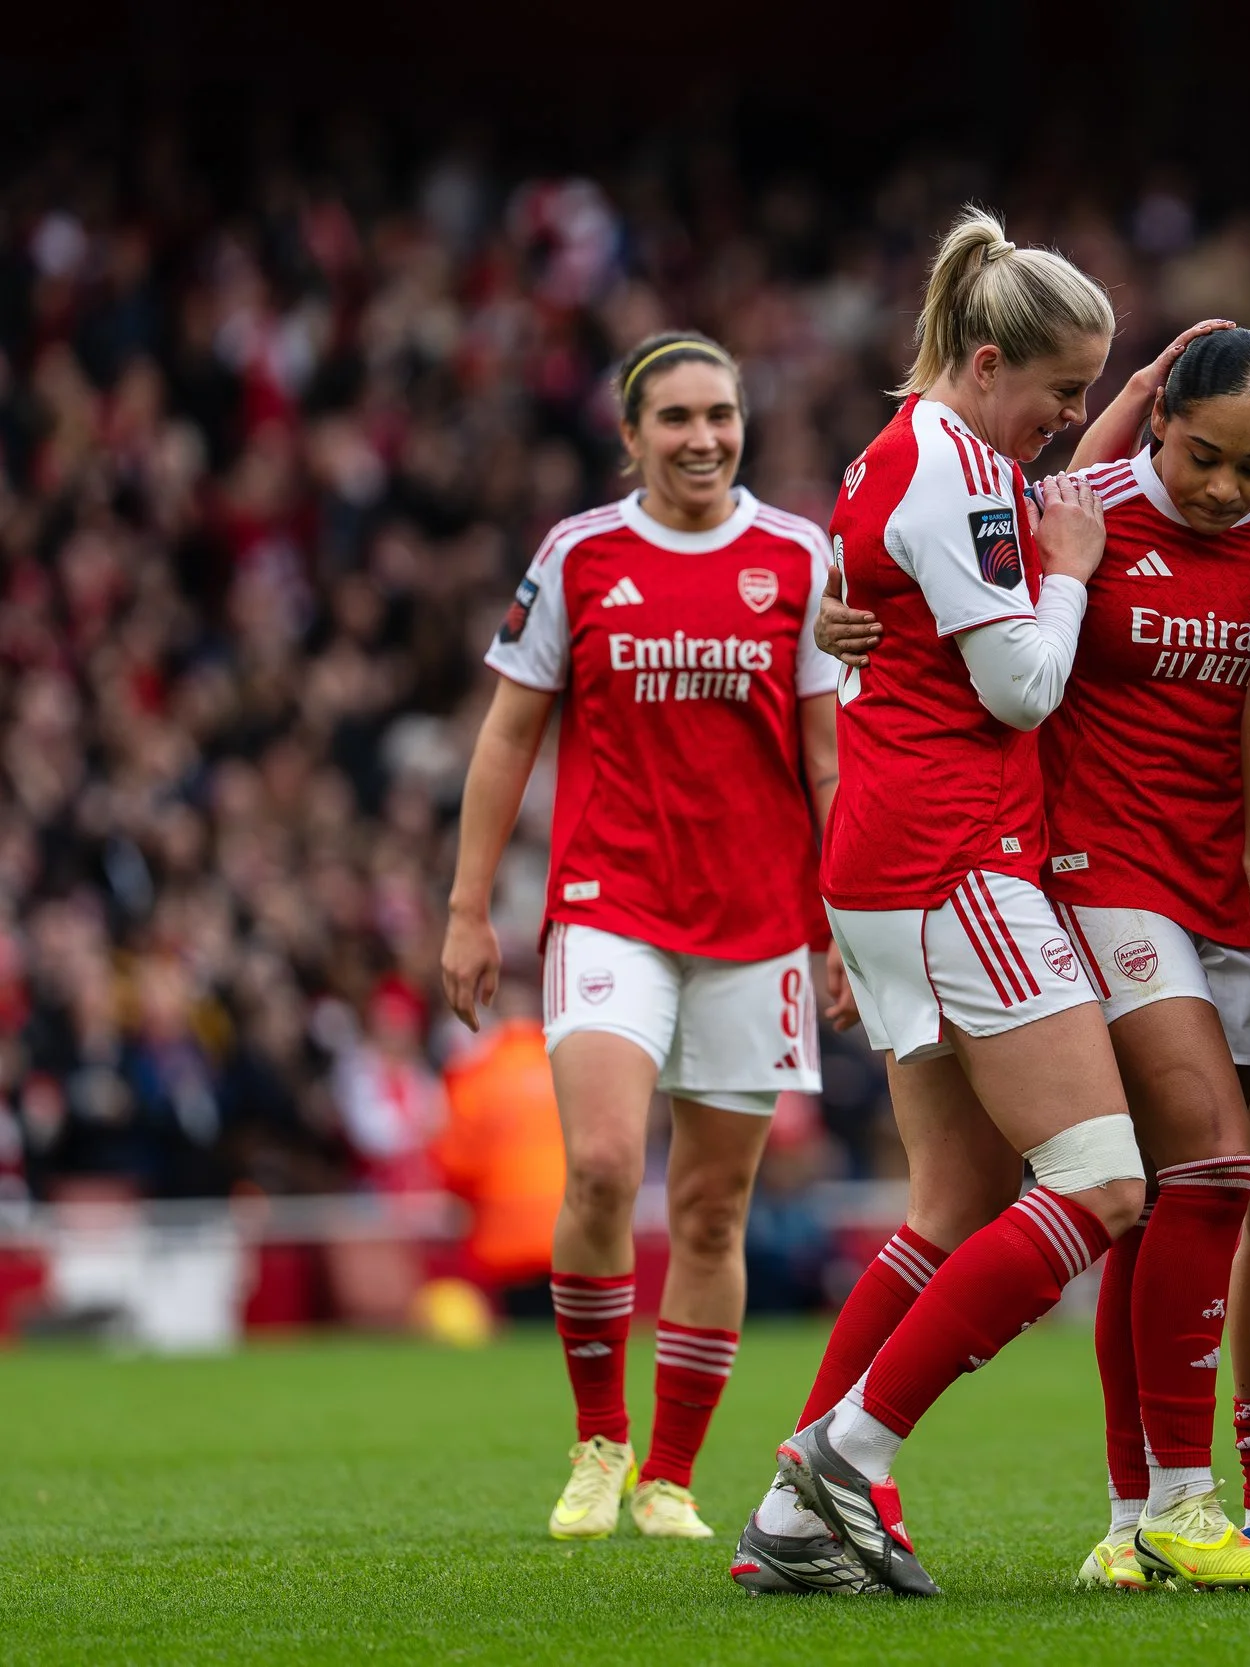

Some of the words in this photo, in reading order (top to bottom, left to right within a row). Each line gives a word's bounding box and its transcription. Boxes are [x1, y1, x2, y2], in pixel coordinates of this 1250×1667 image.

[977, 521, 1013, 538] WSL
[608, 629, 773, 671] Emirates
[1152, 651, 1196, 679] FLY
[635, 672, 670, 703] FLY
[674, 671, 751, 702] BETTER
[1047, 944, 1069, 957] Arsenal
[1120, 945, 1149, 960] Arsenal
[781, 967, 801, 1038] 8
